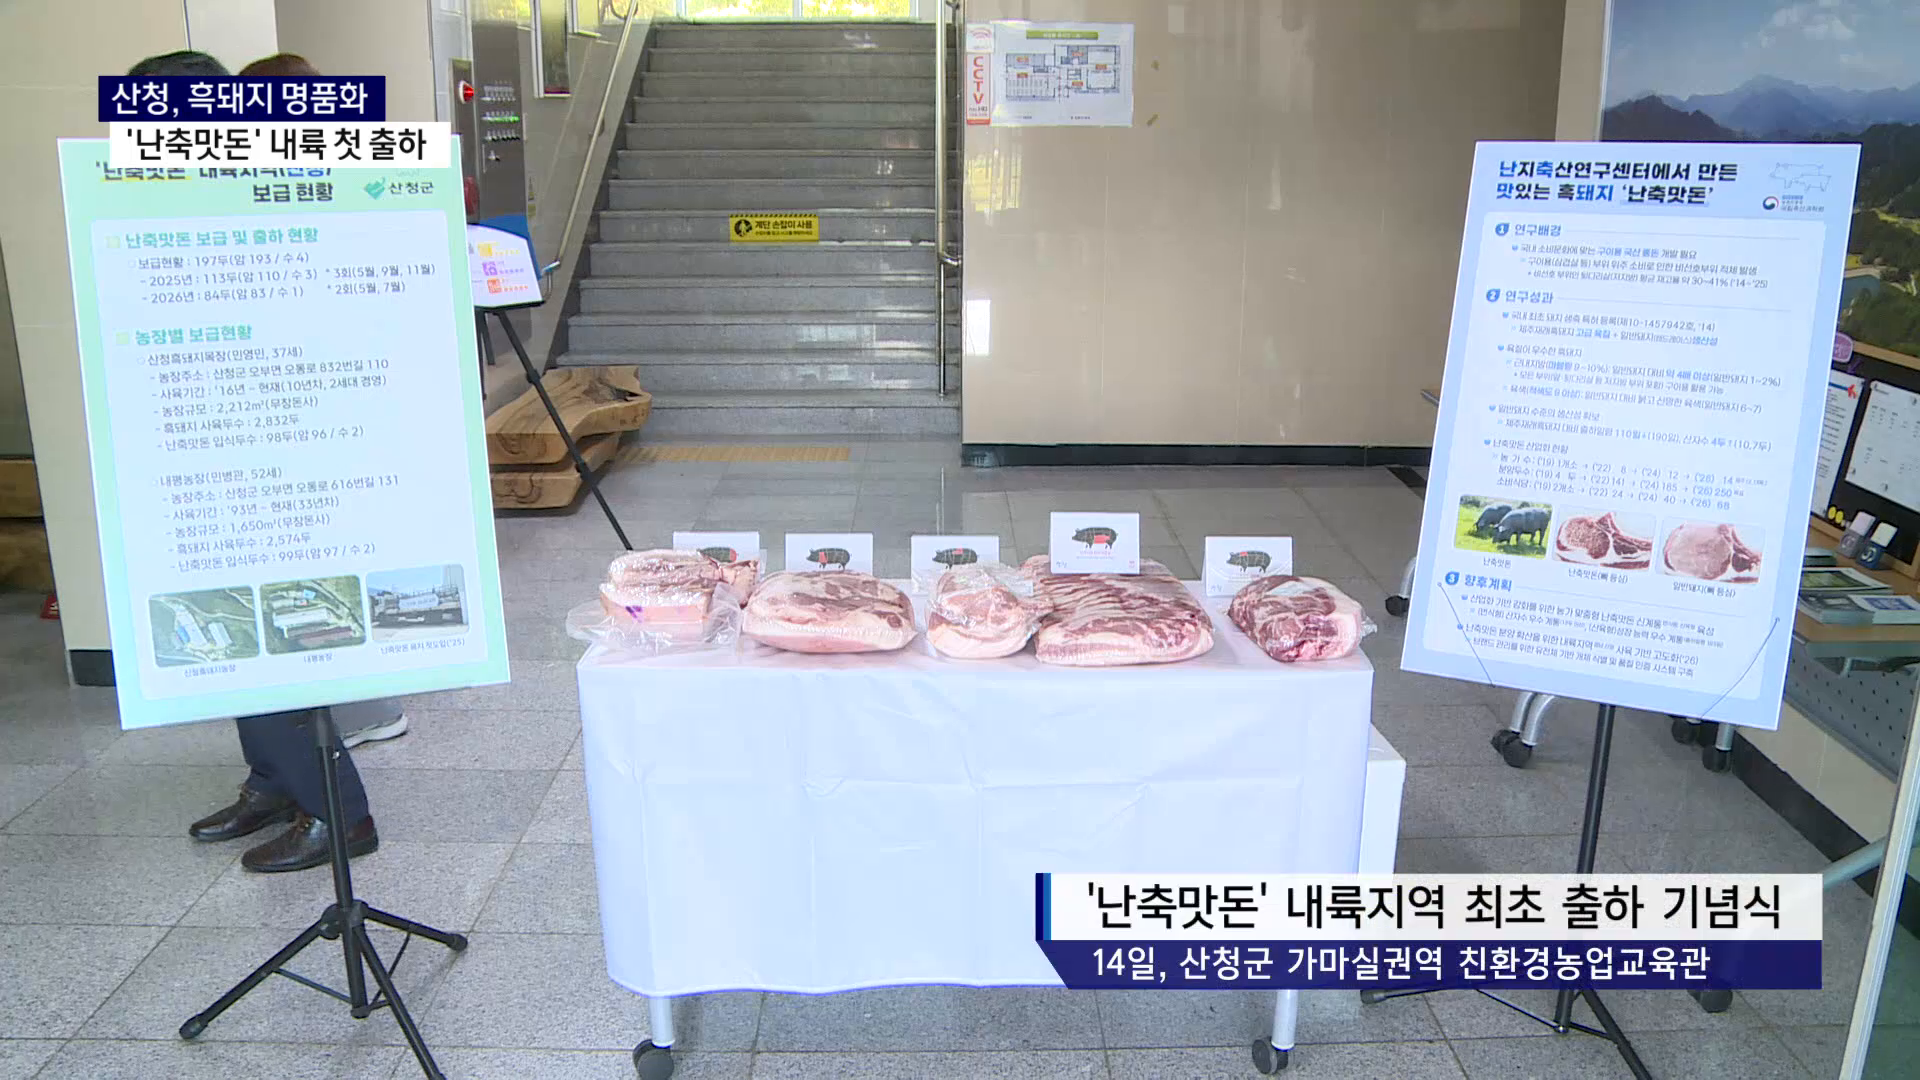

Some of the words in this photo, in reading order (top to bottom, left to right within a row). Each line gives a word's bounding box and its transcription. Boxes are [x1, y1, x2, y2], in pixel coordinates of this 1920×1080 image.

[973, 56, 984, 104] CCTV
[1499, 160, 1690, 180] 난지축산연구센터에서
[1697, 163, 1737, 181] 만든
[253, 184, 290, 203] 보급
[296, 182, 333, 202] 현황
[388, 181, 434, 196] 산청군
[1496, 182, 1549, 199] 맛있는
[1557, 183, 1613, 201] 흑돼지
[755, 220, 770, 229] 계단
[772, 220, 796, 229] 손잡이
[797, 220, 812, 229] 사용
[1514, 224, 1561, 236] 연구배경
[125, 231, 191, 248] 난축맛돈
[196, 230, 227, 246] 보급
[231, 230, 247, 245] 및
[253, 228, 283, 244] 출하
[287, 227, 318, 242] 현황
[138, 256, 183, 269] 보급현황
[194, 254, 245, 267] 197두(암
[249, 253, 271, 264] 193
[283, 252, 293, 263] 수
[296, 251, 309, 263] 4)
[149, 273, 192, 286] 2025년
[203, 271, 253, 284] 113두(암
[258, 270, 280, 281] 110
[291, 269, 301, 280] 수
[305, 268, 317, 280] 3)
[333, 266, 378, 278] 3회(5월,
[381, 264, 402, 276] 9월,
[407, 263, 435, 275] 11월)
[150, 290, 194, 303] 2026년
[203, 288, 247, 301] 84두(암
[250, 287, 265, 299] 83
[277, 286, 288, 298] 수
[292, 285, 303, 297] 1)
[335, 282, 379, 294] 2회(5월,
[384, 281, 405, 292] 7월)
[1505, 290, 1553, 303] 연구성과
[135, 327, 184, 345] 농장별
[189, 324, 252, 342] 보급현황
[271, 346, 302, 358] 37세)
[158, 369, 202, 383] 농장주소
[213, 367, 245, 380] 산청군
[249, 364, 281, 377] 오부면
[319, 359, 363, 372] 832번길
[368, 358, 388, 370] 110
[162, 403, 206, 417] 농장규모
[164, 420, 197, 434] 흑돼지
[200, 418, 244, 431] 사육두수
[254, 413, 299, 428] 2,832두
[164, 436, 210, 451] 난축맛돈
[212, 433, 256, 447] 입식두수
[265, 429, 308, 443] 98두(암
[311, 428, 326, 439] 96
[338, 427, 348, 438] 수
[351, 424, 363, 437] 2)
[250, 466, 281, 479] 52세)
[171, 489, 215, 504] 농장주소
[225, 485, 257, 499] 산청군
[260, 482, 293, 496] 오부면
[330, 475, 374, 490] 616번길
[378, 474, 398, 486] 131
[172, 506, 217, 521] 사육기간
[270, 495, 339, 512] 현재(33년차)
[175, 523, 219, 538] 농장규모
[177, 541, 210, 554] 흑돼지
[213, 537, 256, 551] 사육두수
[266, 531, 310, 547] 2,574두
[178, 556, 222, 572] 난축맛돈
[224, 552, 268, 567] 입식두수
[278, 547, 321, 561] 99두(암
[323, 545, 338, 557] 97
[349, 544, 360, 555] 수
[363, 541, 375, 553] 2)
[1483, 556, 1511, 568] 난축맛돈
[1464, 574, 1512, 591] 향후계획
